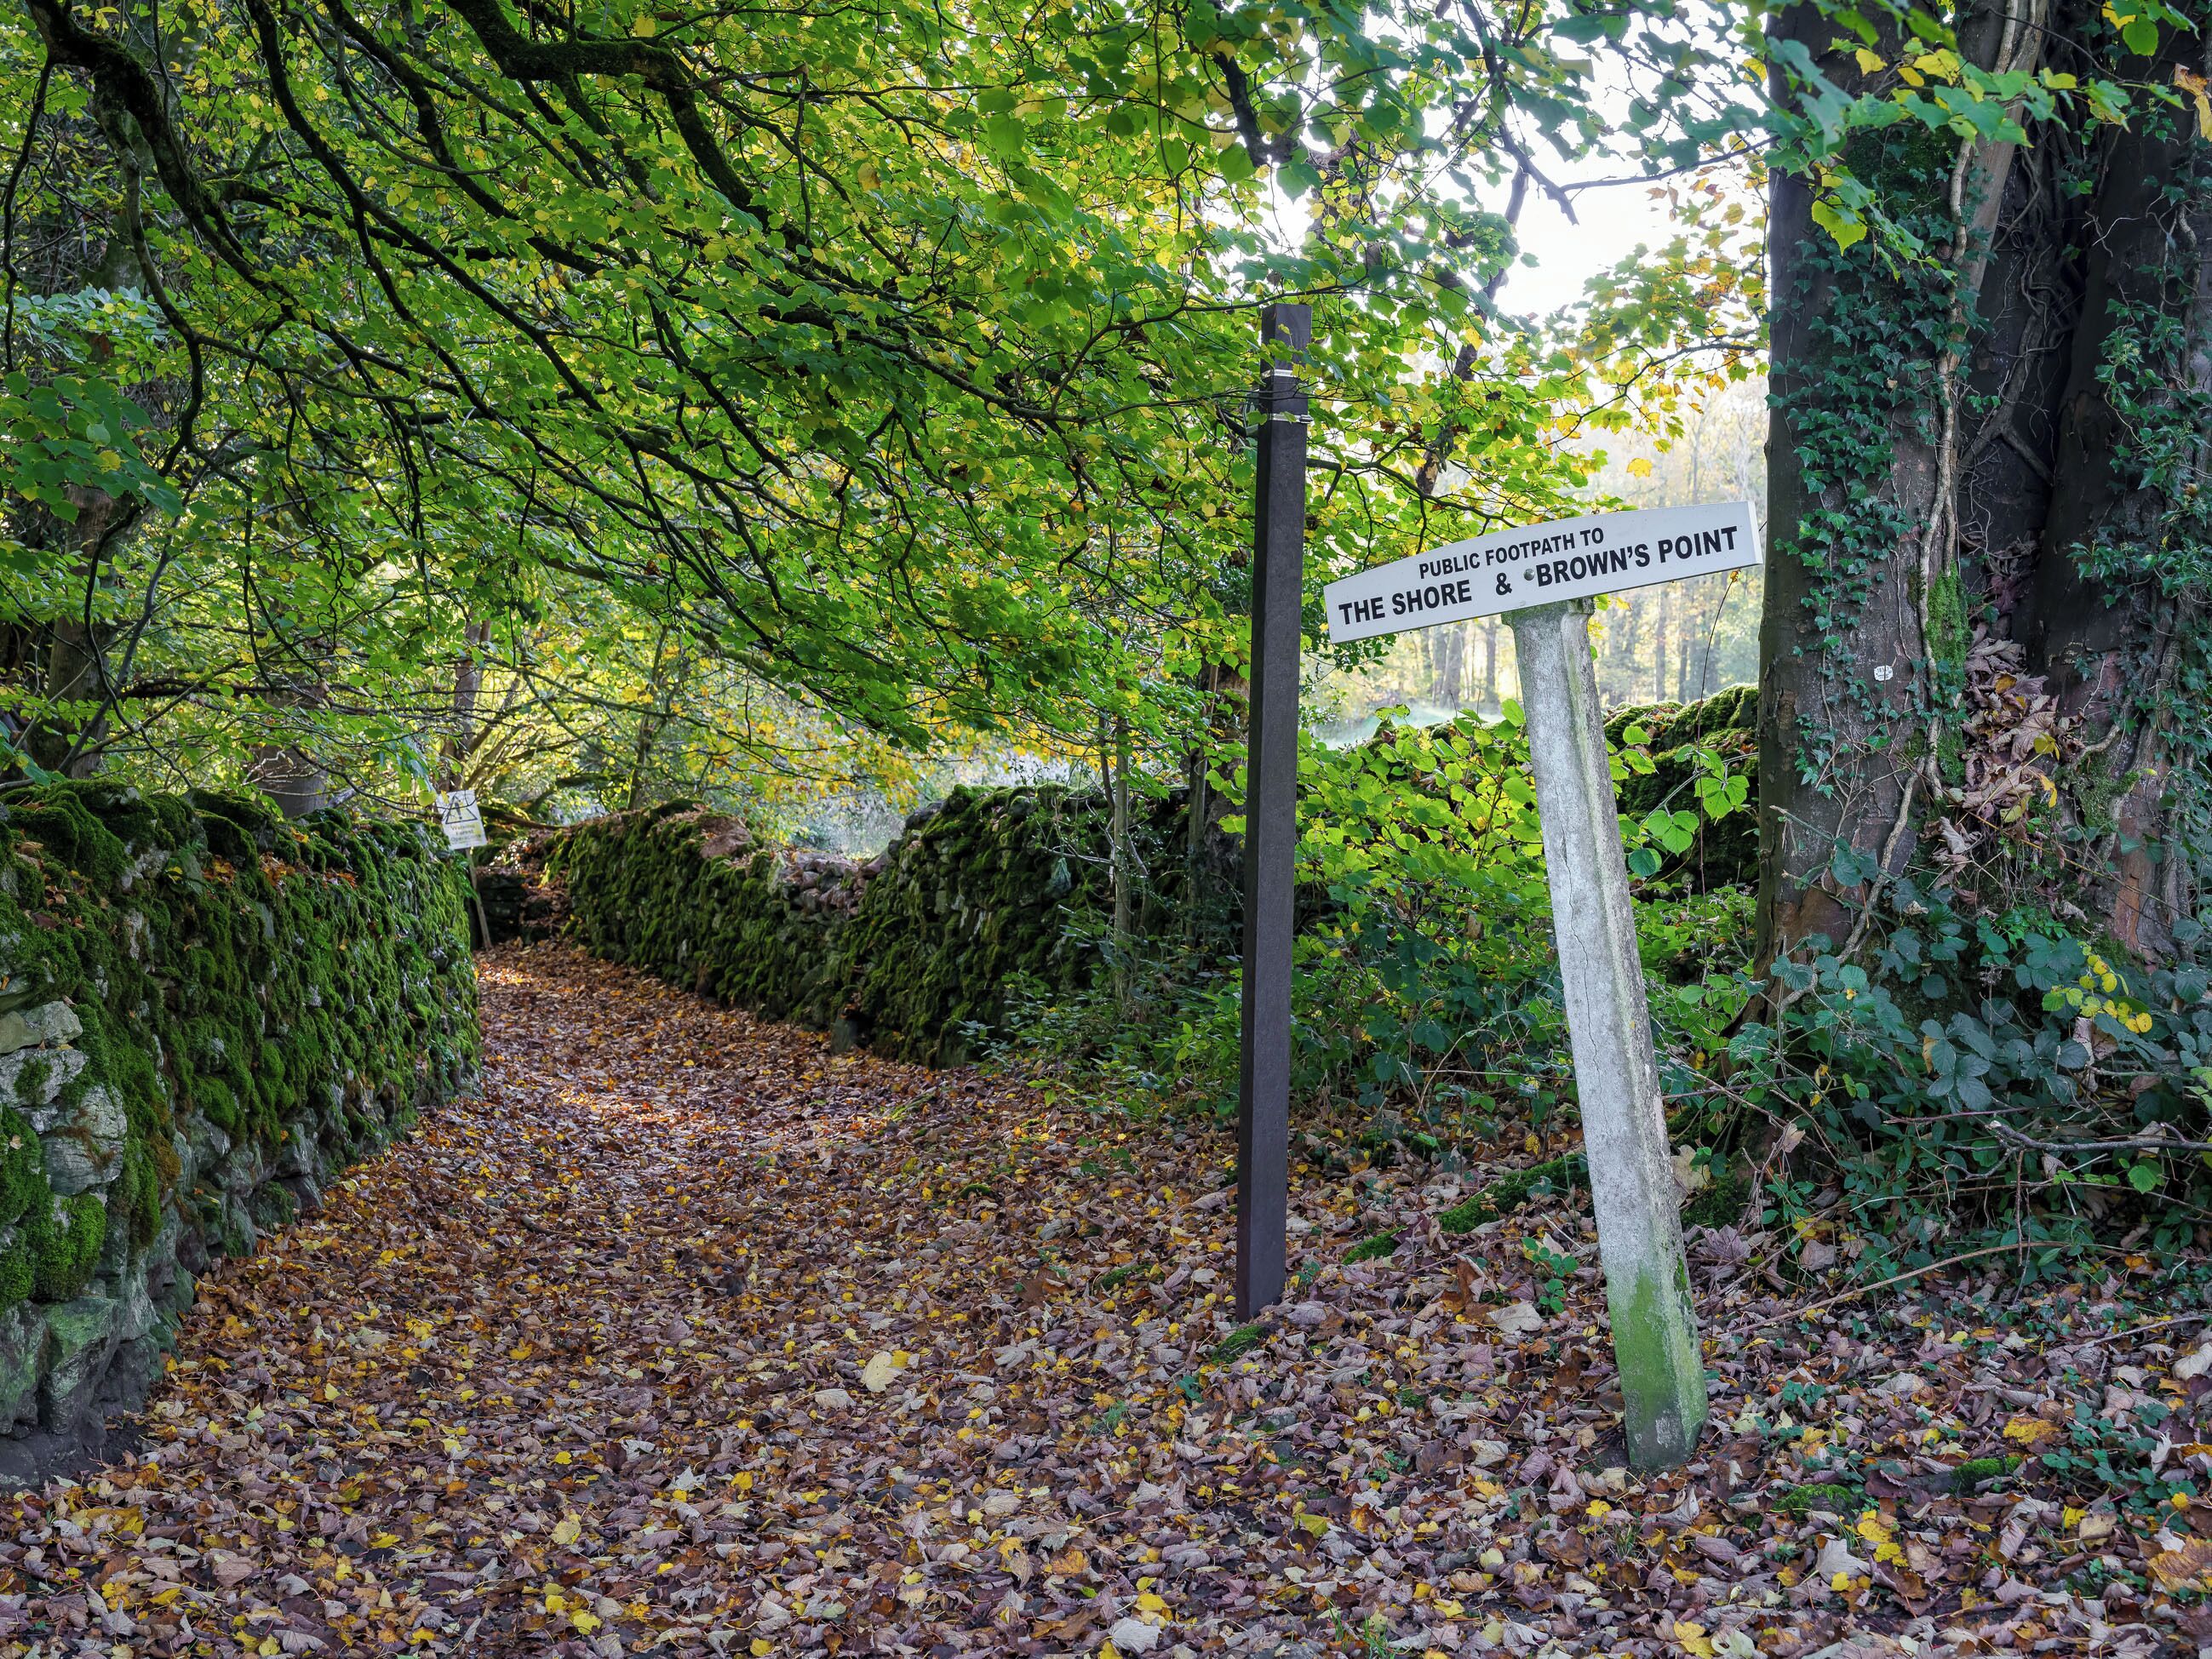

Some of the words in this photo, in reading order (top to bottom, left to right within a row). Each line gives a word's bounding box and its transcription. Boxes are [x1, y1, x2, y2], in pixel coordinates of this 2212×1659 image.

[1338, 596, 1384, 626] THE
[1391, 580, 1472, 615] SHORE
[1496, 572, 1513, 596] &
[1536, 542, 1651, 588] BROWN'S
[1658, 525, 1739, 563] POINT
[1419, 546, 1481, 579] PUBLIC
[1486, 538, 1575, 569] FOOTPATH
[1580, 527, 1604, 546] TO
